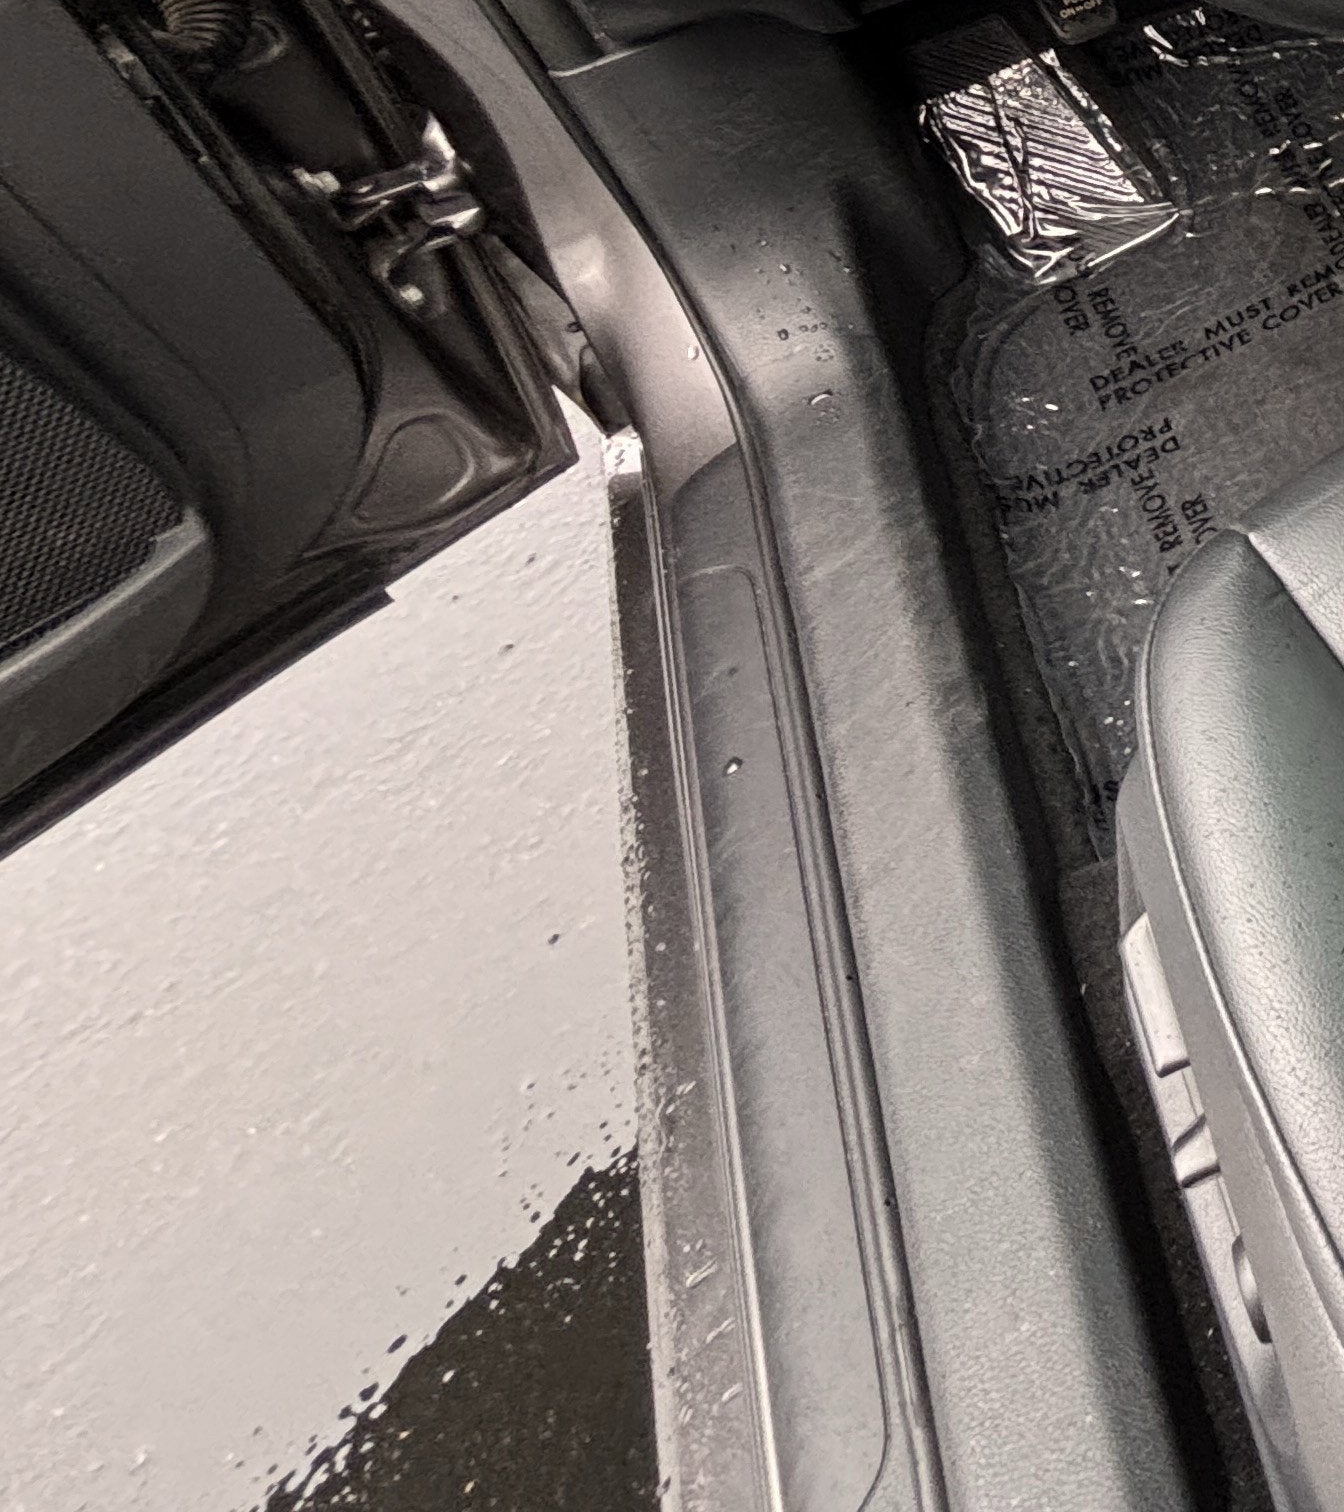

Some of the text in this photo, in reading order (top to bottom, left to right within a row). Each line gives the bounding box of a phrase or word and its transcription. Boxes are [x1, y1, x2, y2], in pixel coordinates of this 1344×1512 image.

[1053, 285, 1091, 337] OVER
[1087, 287, 1138, 361] REMOVE
[1089, 340, 1185, 395] DEALER
[1204, 297, 1273, 341] MUST
[1098, 280, 1344, 411] PROTECTIVE COVER
[1078, 435, 1181, 495] DEALER
[1130, 468, 1184, 553] REMOVE
